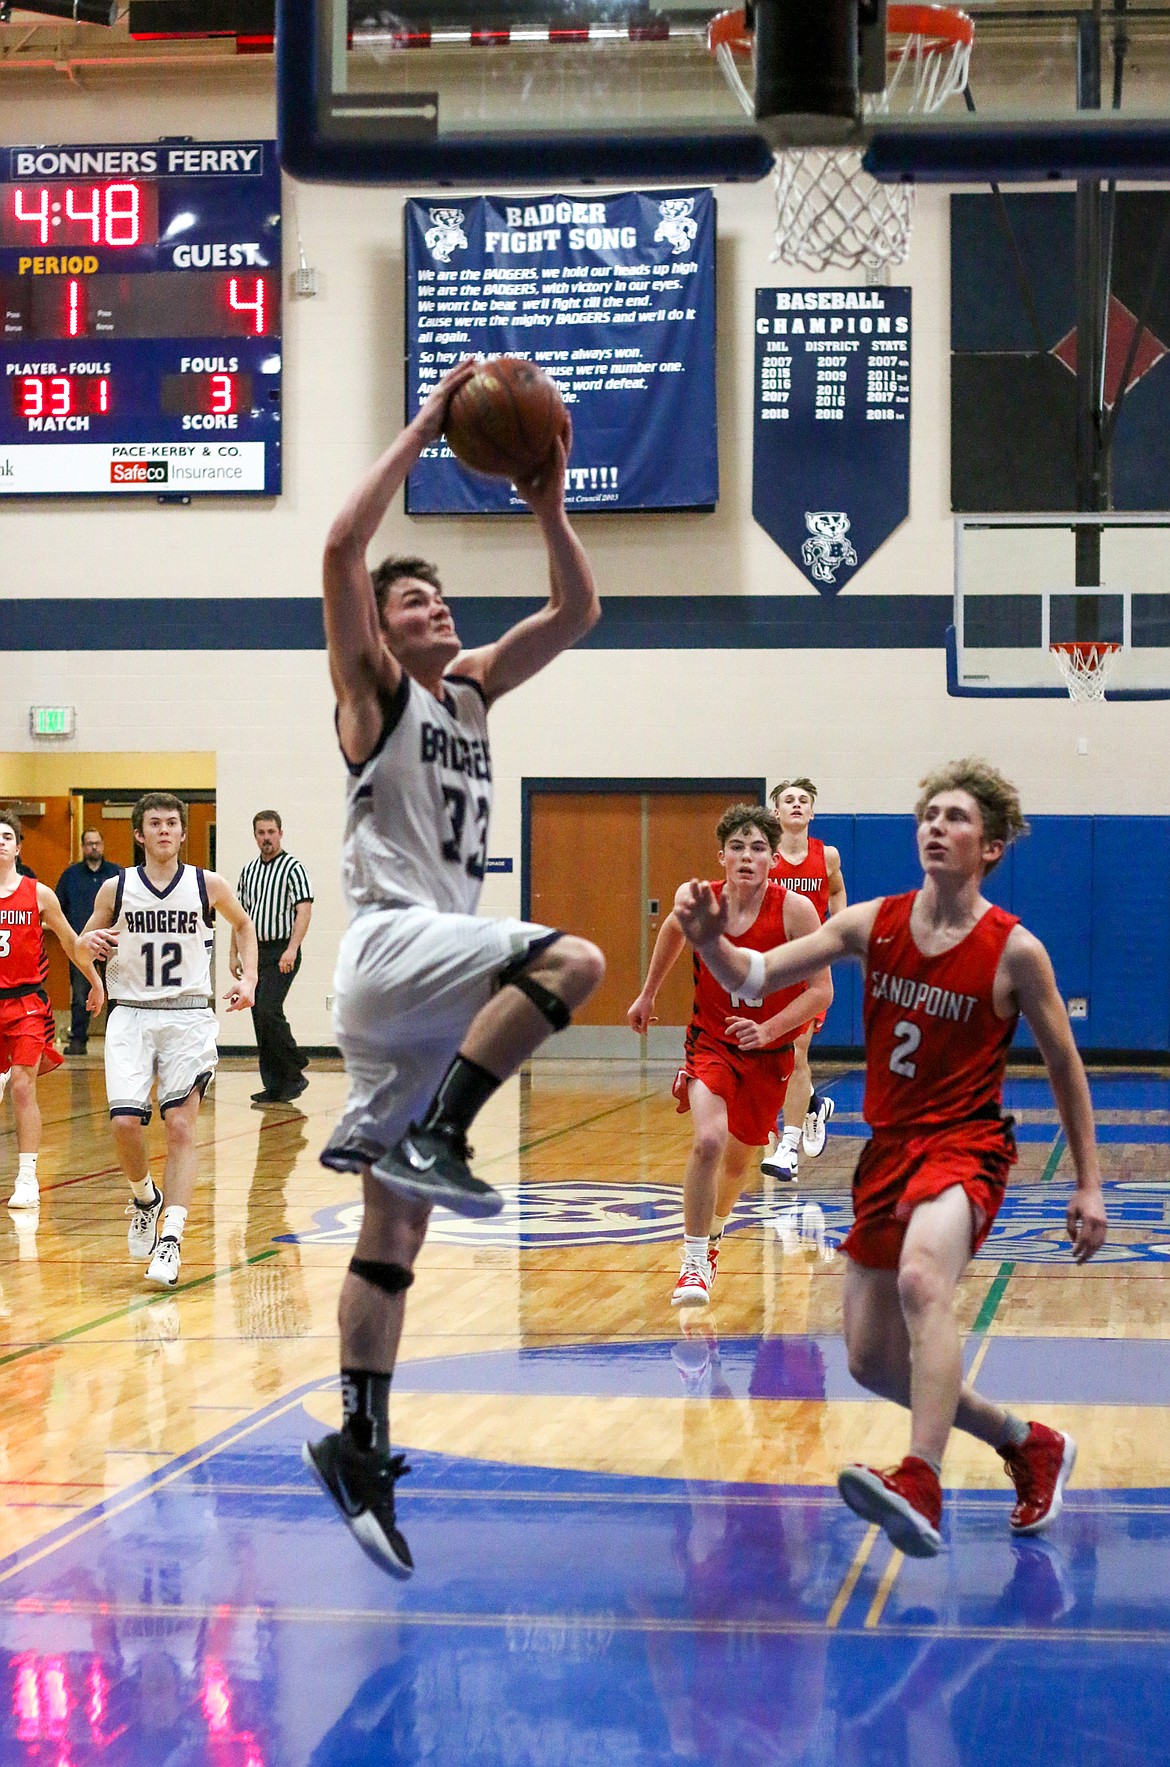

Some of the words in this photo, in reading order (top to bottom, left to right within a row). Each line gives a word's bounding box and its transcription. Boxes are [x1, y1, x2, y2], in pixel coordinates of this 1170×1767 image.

[17, 151, 157, 175] BONNERS
[168, 149, 259, 172] FERRY
[14, 183, 140, 246] 4:48
[506, 202, 606, 227] BADGER
[485, 230, 561, 253] FIGHT
[569, 227, 637, 249] SONG
[172, 243, 261, 268] GUEST
[18, 255, 99, 276] PERIOD
[418, 270, 435, 280] We
[437, 271, 458, 280] are
[460, 269, 481, 280] the
[483, 268, 539, 279] BADGERS,
[542, 268, 560, 278] we
[562, 266, 588, 277] hold
[590, 267, 612, 277] our
[614, 264, 650, 276] heads
[653, 265, 669, 276] up
[671, 262, 698, 275] high
[418, 286, 435, 296] We
[437, 287, 458, 296] are
[460, 285, 481, 296] the
[483, 283, 539, 295] BADGERS,
[542, 282, 569, 294] with
[571, 281, 612, 293] victory
[615, 281, 626, 291] in
[628, 281, 650, 291] our
[652, 280, 683, 292] eyes.
[70, 281, 78, 335] 1
[229, 278, 265, 334] 4
[418, 301, 435, 312] We
[472, 300, 487, 311] be
[523, 298, 549, 310] we'll
[552, 297, 580, 311] fight
[583, 296, 601, 308] till
[603, 296, 623, 308] the
[625, 295, 653, 307] end.
[776, 292, 884, 310] BASEBALL
[418, 316, 452, 327] Cause
[455, 316, 487, 327] we're
[489, 315, 509, 326] the
[511, 314, 553, 327] mighty
[555, 312, 611, 324] BADGERS
[612, 311, 636, 322] and
[639, 310, 665, 322] we'll
[668, 309, 684, 320] do
[686, 309, 696, 320] it
[756, 317, 909, 334] CHAMPIONS
[418, 332, 433, 343] all
[435, 331, 471, 344] again.
[767, 341, 789, 352] IML
[805, 341, 860, 352] DISTRICT
[871, 340, 908, 351] STATE
[419, 352, 434, 363] So
[436, 351, 457, 364] hey
[571, 349, 612, 360] always
[614, 348, 643, 359] won.
[762, 357, 792, 368] 2007
[817, 356, 847, 367] 2007
[868, 355, 898, 367] 2007
[6, 364, 58, 375] PLAYER
[70, 363, 111, 374] FOULS
[181, 357, 239, 373] FOULS
[419, 367, 437, 378] We
[576, 364, 608, 375] we're
[610, 362, 657, 374] number
[659, 361, 685, 372] one.
[817, 371, 847, 381] 2009
[867, 370, 896, 381] 2011
[417, 382, 436, 394] An
[555, 380, 570, 391] he
[573, 378, 603, 391] word
[605, 378, 648, 390] defeat,
[761, 379, 791, 390] 2016
[817, 385, 845, 396] 2011
[867, 381, 898, 392] 2016
[24, 378, 71, 416] 33
[99, 380, 108, 412] 1
[211, 375, 232, 413] 3
[761, 391, 789, 403] 2017
[815, 396, 845, 407] 2016
[866, 392, 895, 403] 2017
[761, 408, 789, 420] 2018
[815, 409, 844, 420] 2018
[866, 408, 895, 420] 2018
[28, 416, 90, 431] MATCH
[182, 415, 238, 430] SCORE
[112, 447, 196, 457] PACE-KERBY
[202, 446, 211, 457] &
[218, 446, 242, 457] CO.
[0, 459, 15, 477] nk
[113, 464, 165, 482] Safeco
[171, 464, 242, 480] Insurance
[0, 910, 32, 925] POINT
[125, 910, 198, 934] BADGERS
[141, 941, 183, 987] 12
[871, 970, 979, 1023] SANDPOINT
[889, 1020, 922, 1079] 2
